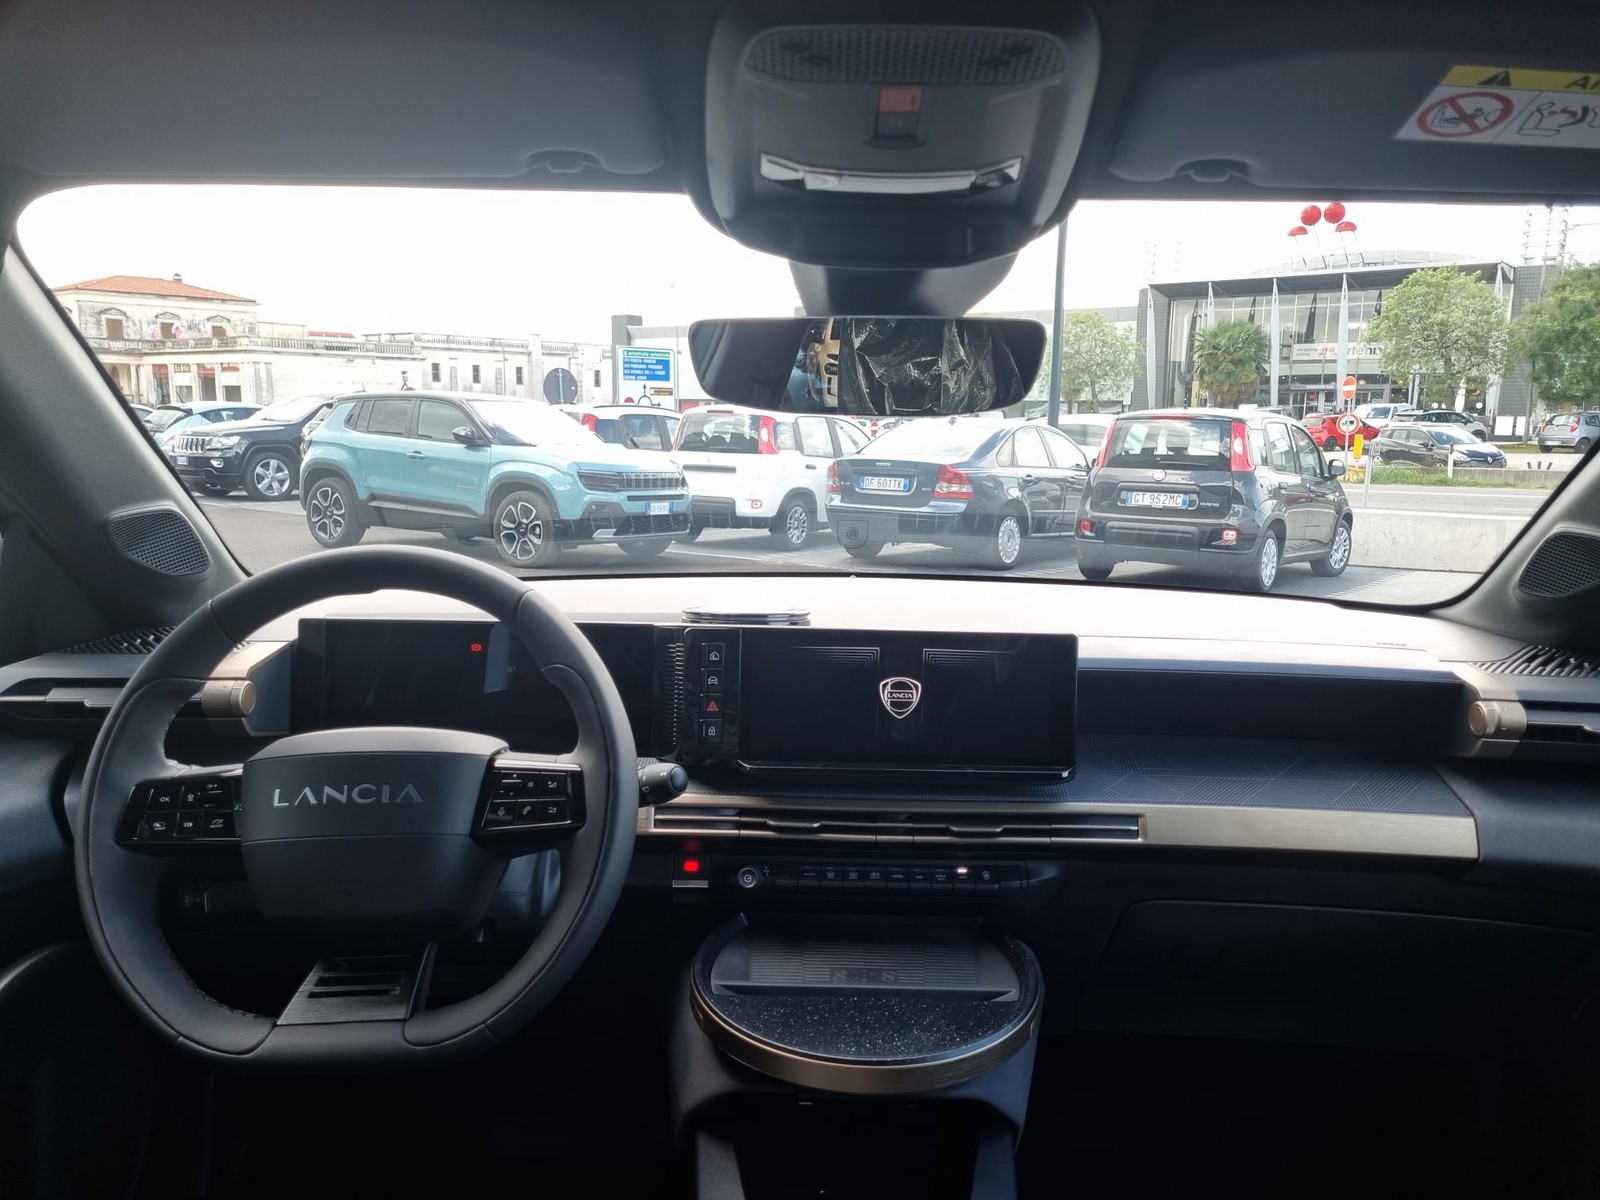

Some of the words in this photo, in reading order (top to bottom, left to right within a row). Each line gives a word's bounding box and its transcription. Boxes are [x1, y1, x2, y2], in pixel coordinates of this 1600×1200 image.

[864, 477, 874, 488] DF
[876, 478, 903, 489] 601TK
[1133, 493, 1146, 504] GT
[1149, 493, 1182, 506] 952MC
[273, 783, 423, 807] LANCIA
